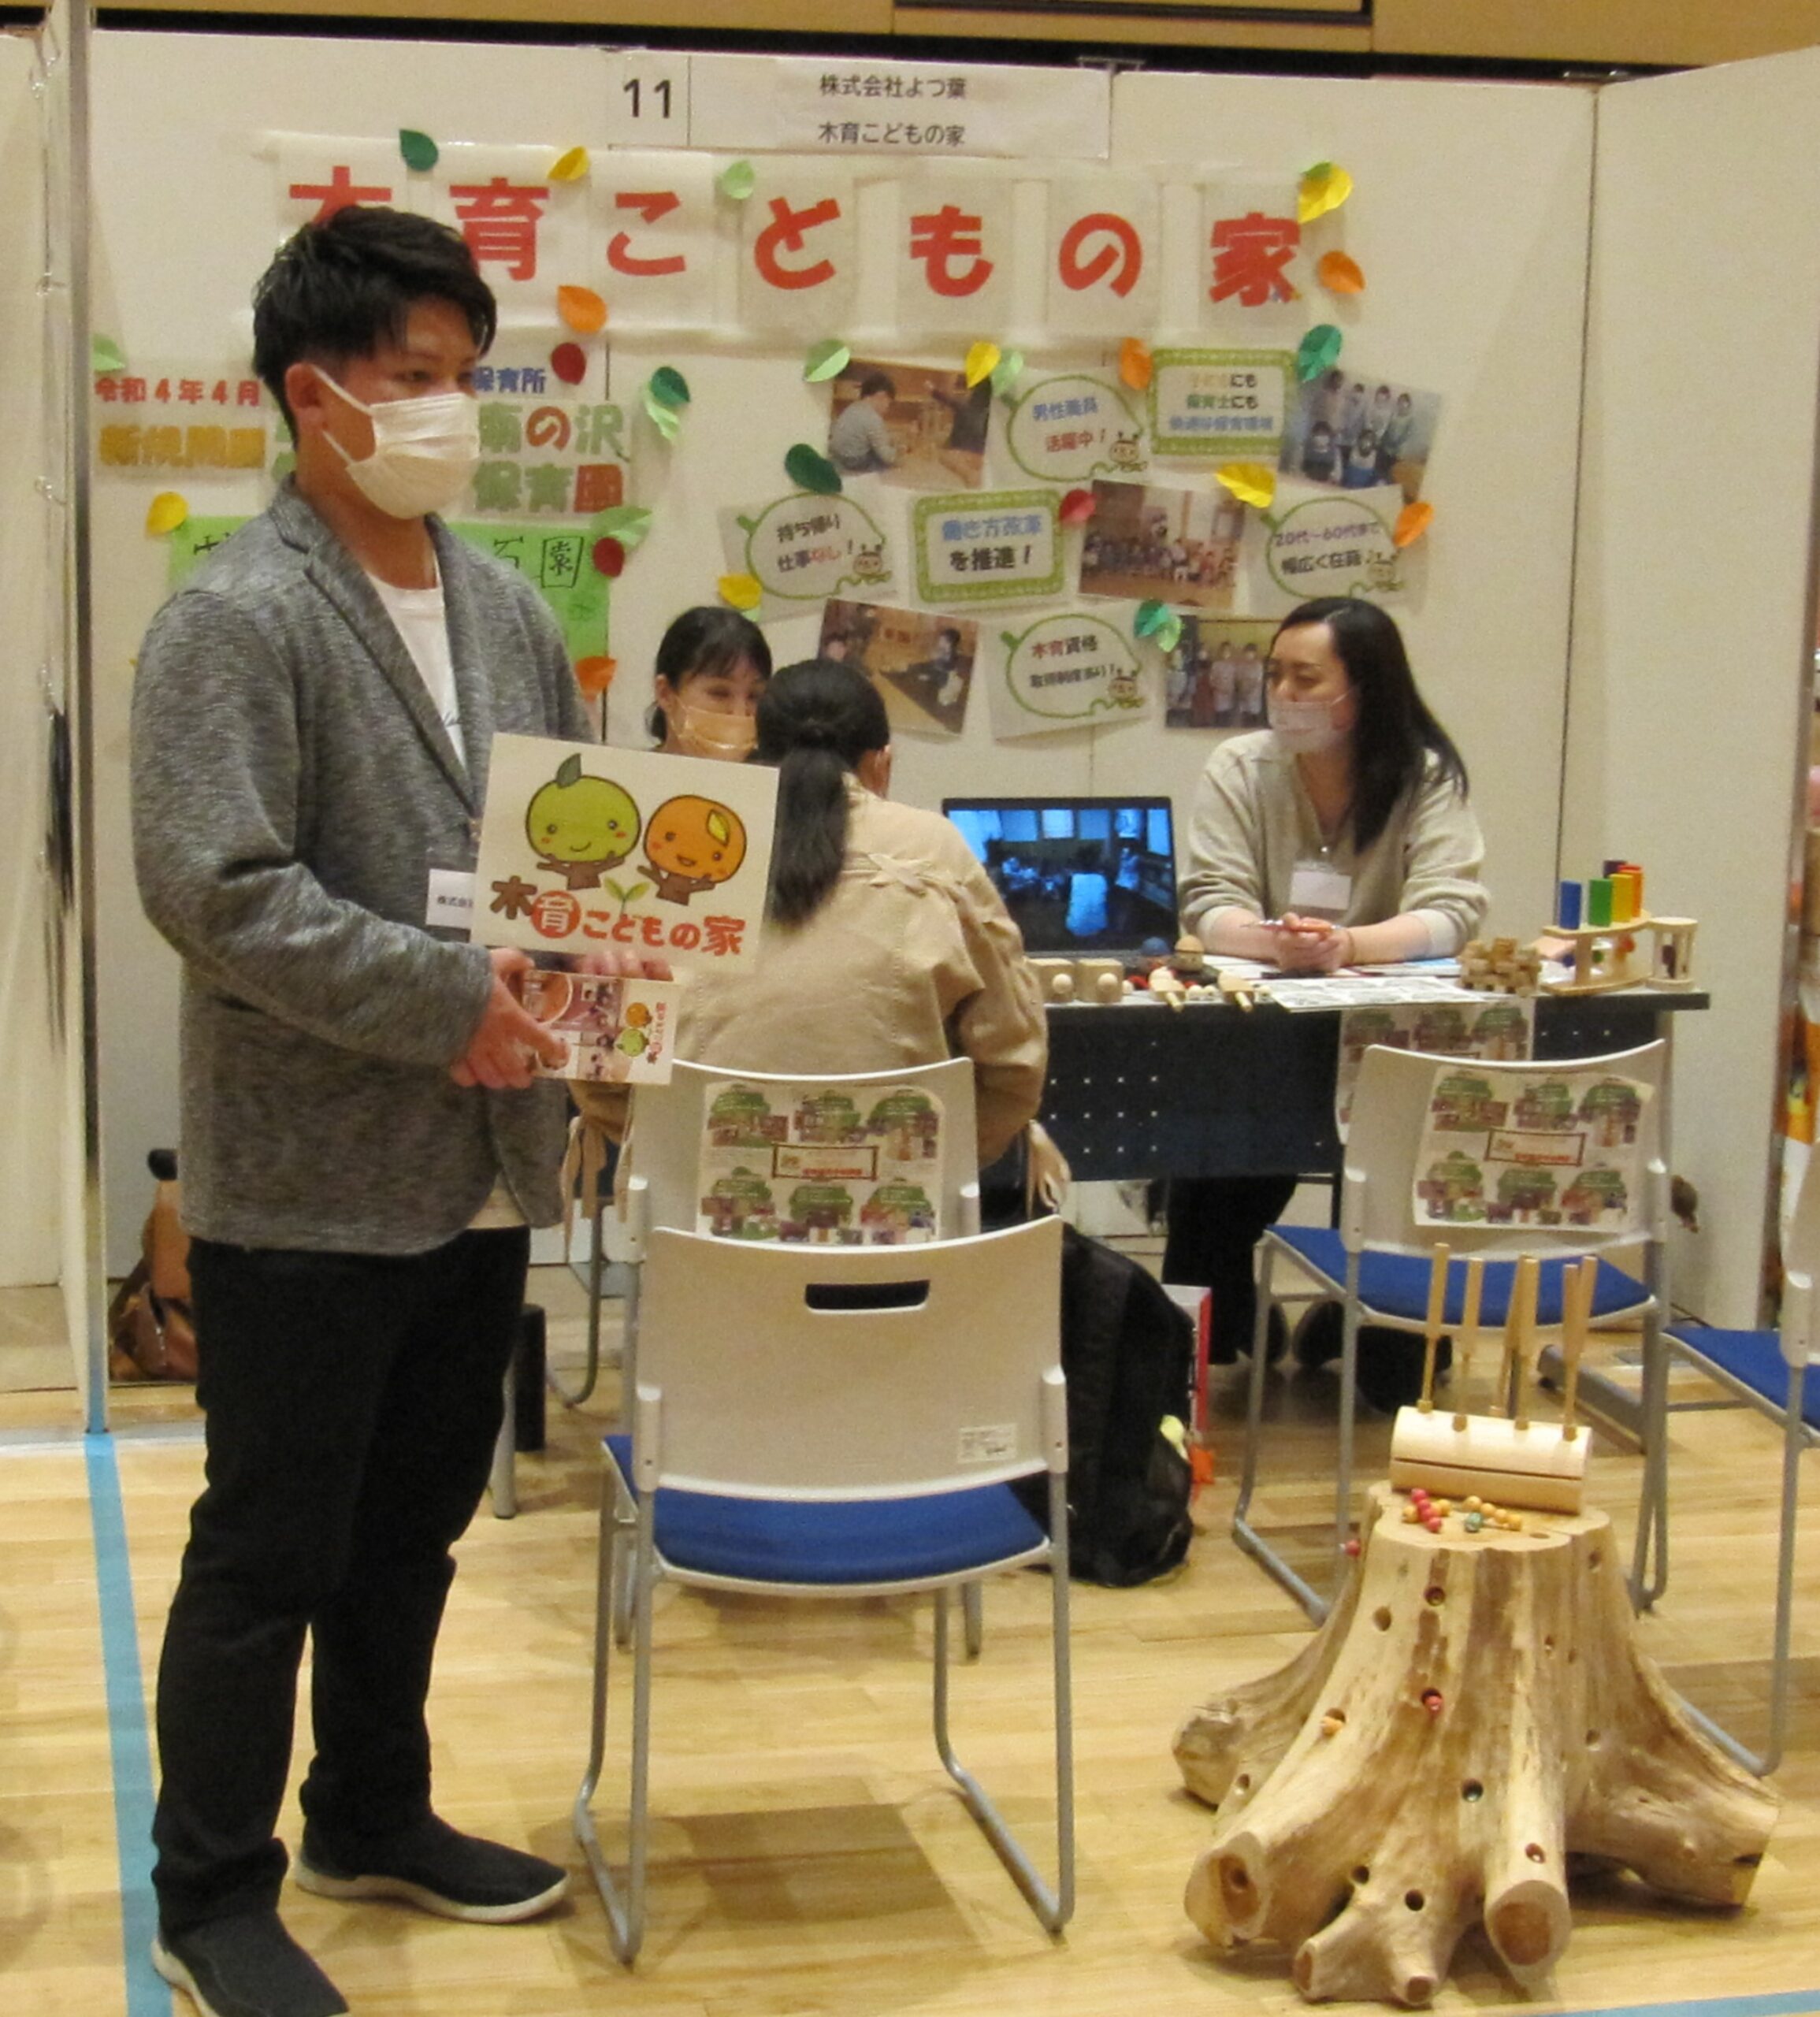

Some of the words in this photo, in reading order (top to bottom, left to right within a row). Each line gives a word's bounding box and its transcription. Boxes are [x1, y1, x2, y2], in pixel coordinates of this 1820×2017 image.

[623, 79, 671, 118] 11
[819, 74, 967, 99] 株式会社よつ葉
[819, 121, 966, 147] 木育こどもの家
[95, 376, 259, 407] 令和4年4月
[489, 875, 745, 956] 木育こどもの家
